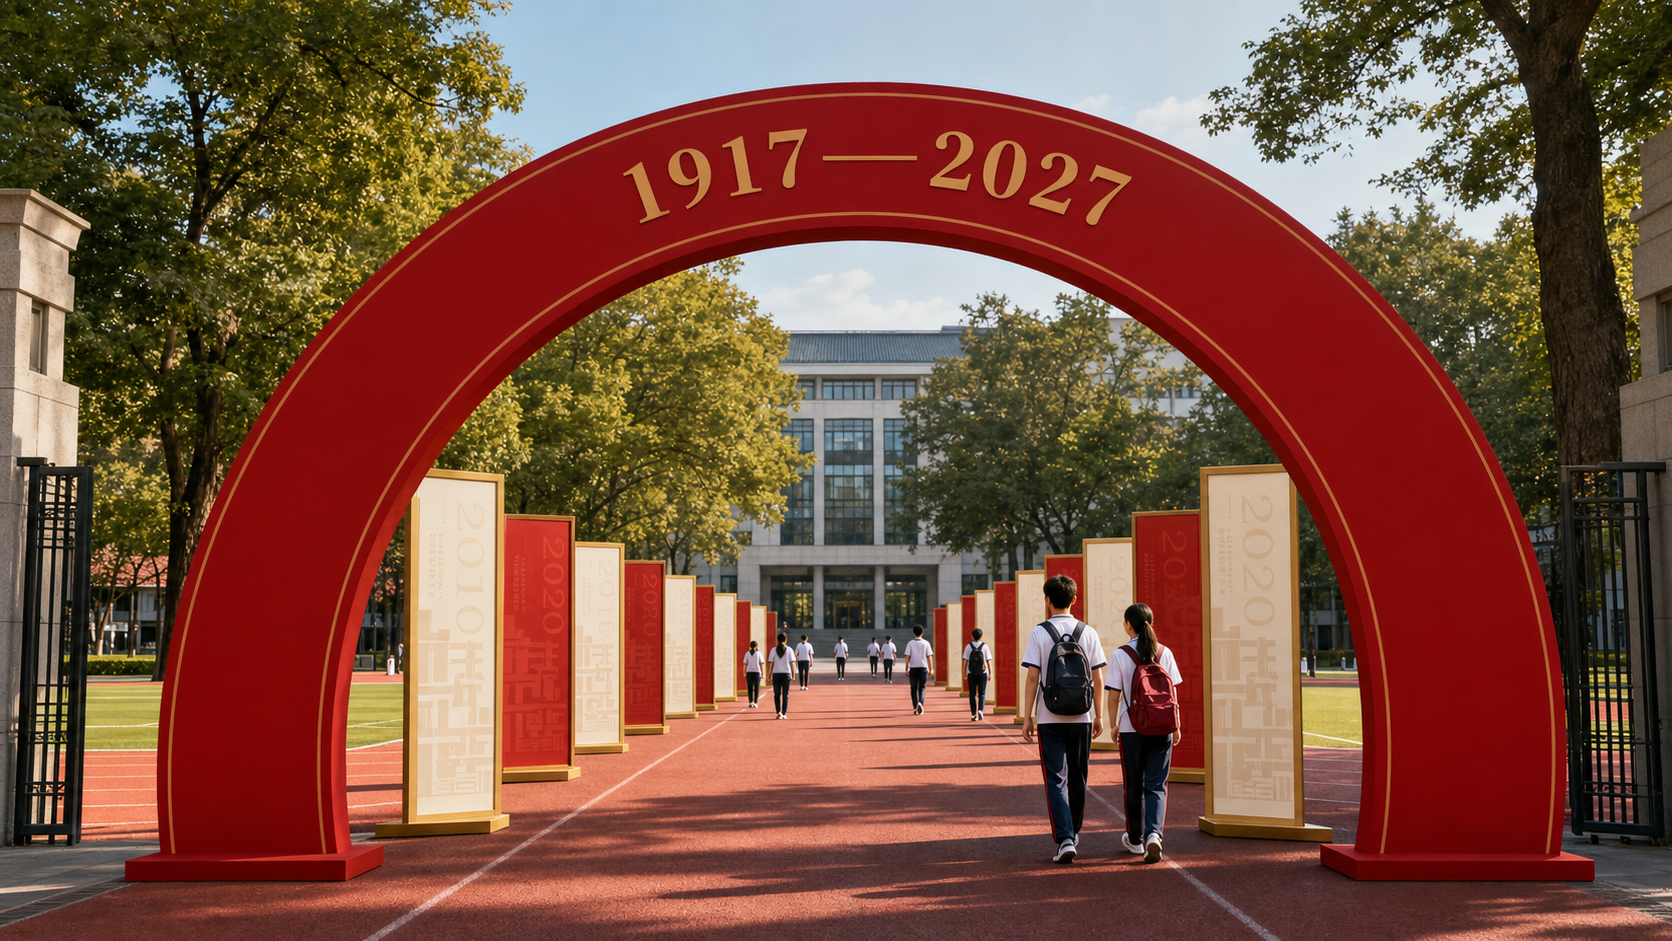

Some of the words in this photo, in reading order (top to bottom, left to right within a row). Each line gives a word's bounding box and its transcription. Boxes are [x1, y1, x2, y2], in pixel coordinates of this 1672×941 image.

[456, 501, 485, 635] 2010
[542, 536, 565, 635] 2020
[598, 560, 615, 637] 2010
[642, 574, 658, 637] 2020
[1241, 494, 1276, 627] 2020
